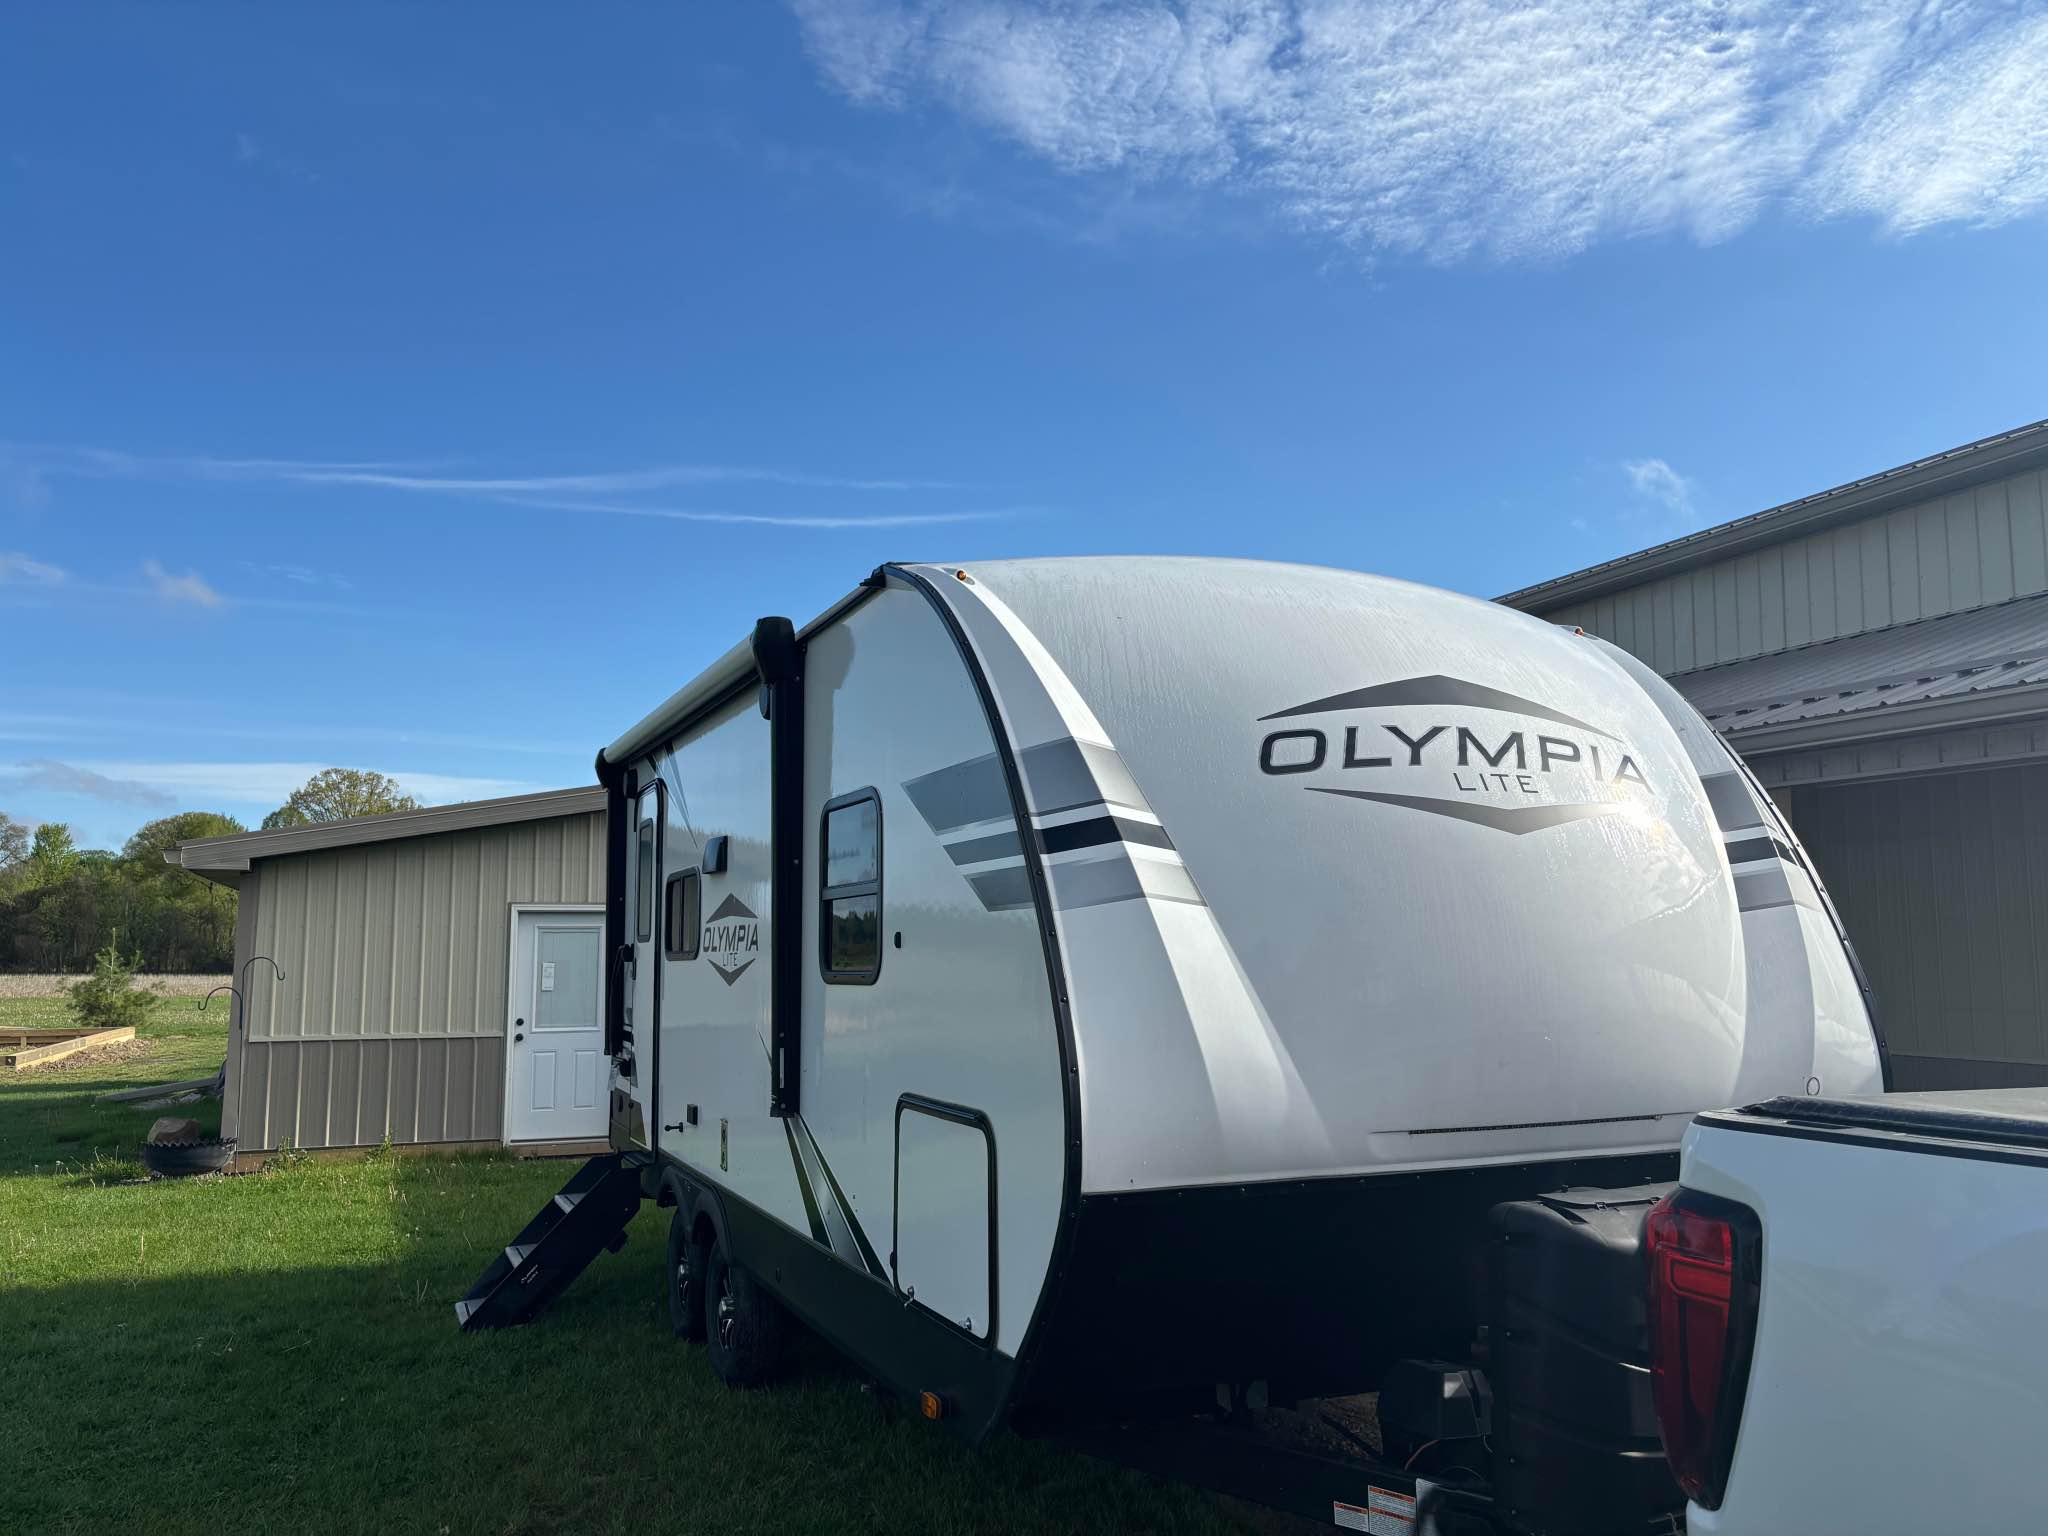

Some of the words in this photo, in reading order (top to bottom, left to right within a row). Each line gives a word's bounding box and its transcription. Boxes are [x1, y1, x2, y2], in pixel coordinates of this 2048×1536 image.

[1259, 725, 1655, 795] OLYMPIA
[1453, 772, 1539, 794] LITE
[703, 923, 759, 952] OLYMPIA
[722, 952, 739, 967] LITE
